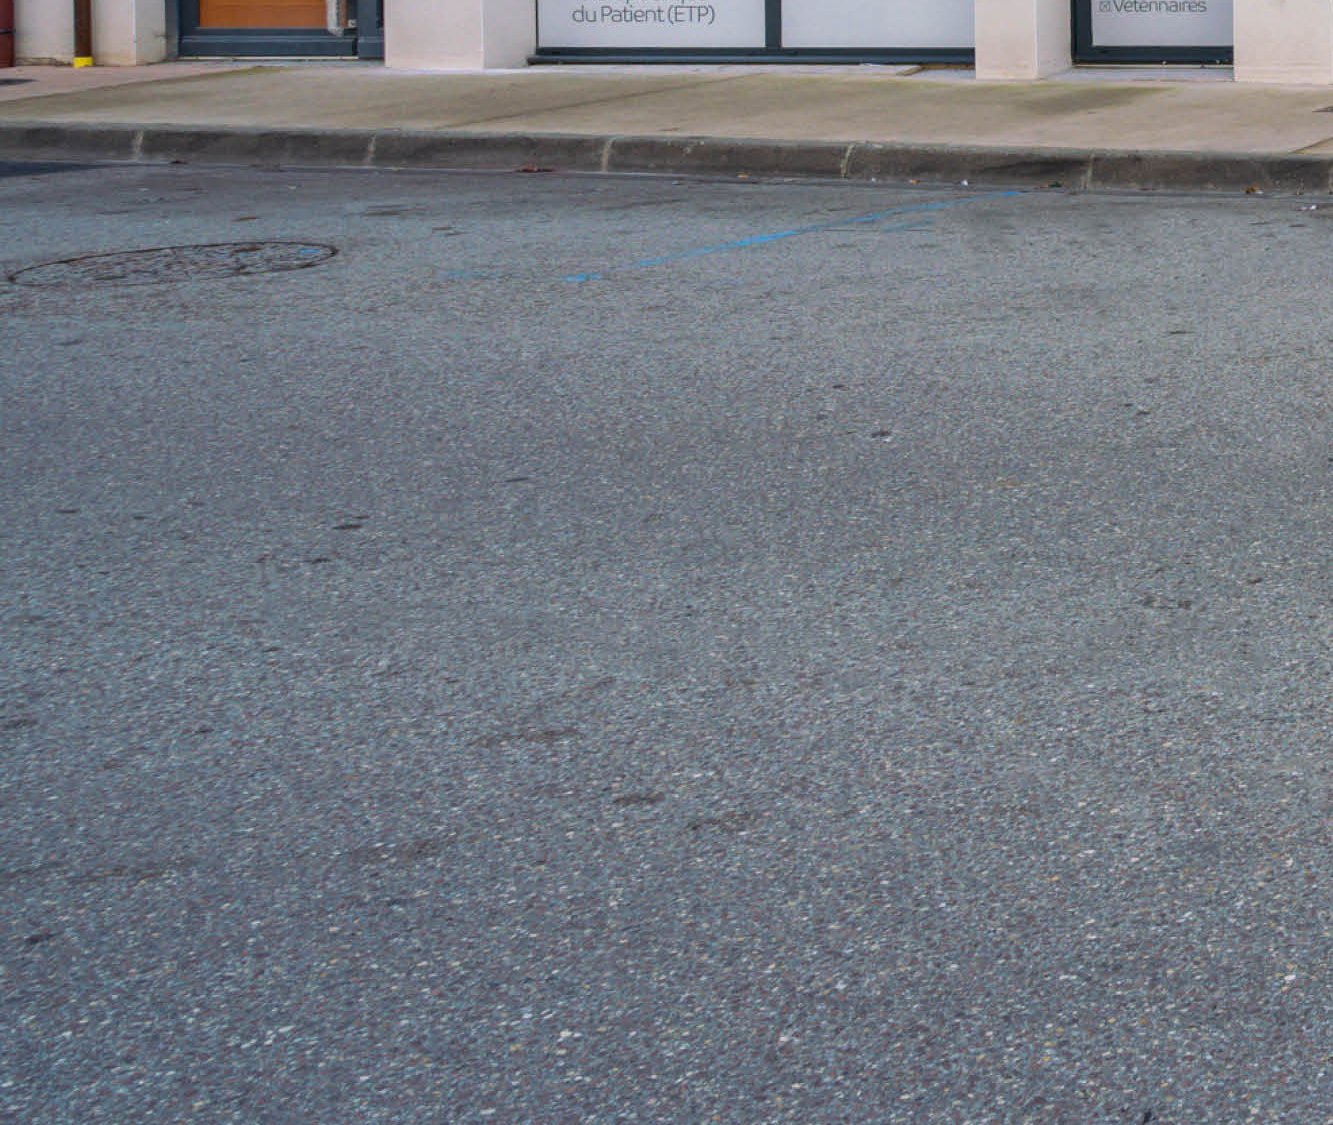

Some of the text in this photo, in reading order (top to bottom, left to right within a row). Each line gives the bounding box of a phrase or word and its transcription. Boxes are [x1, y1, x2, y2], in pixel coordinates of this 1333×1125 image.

[572, 5, 716, 24] du Patient (ETP)
